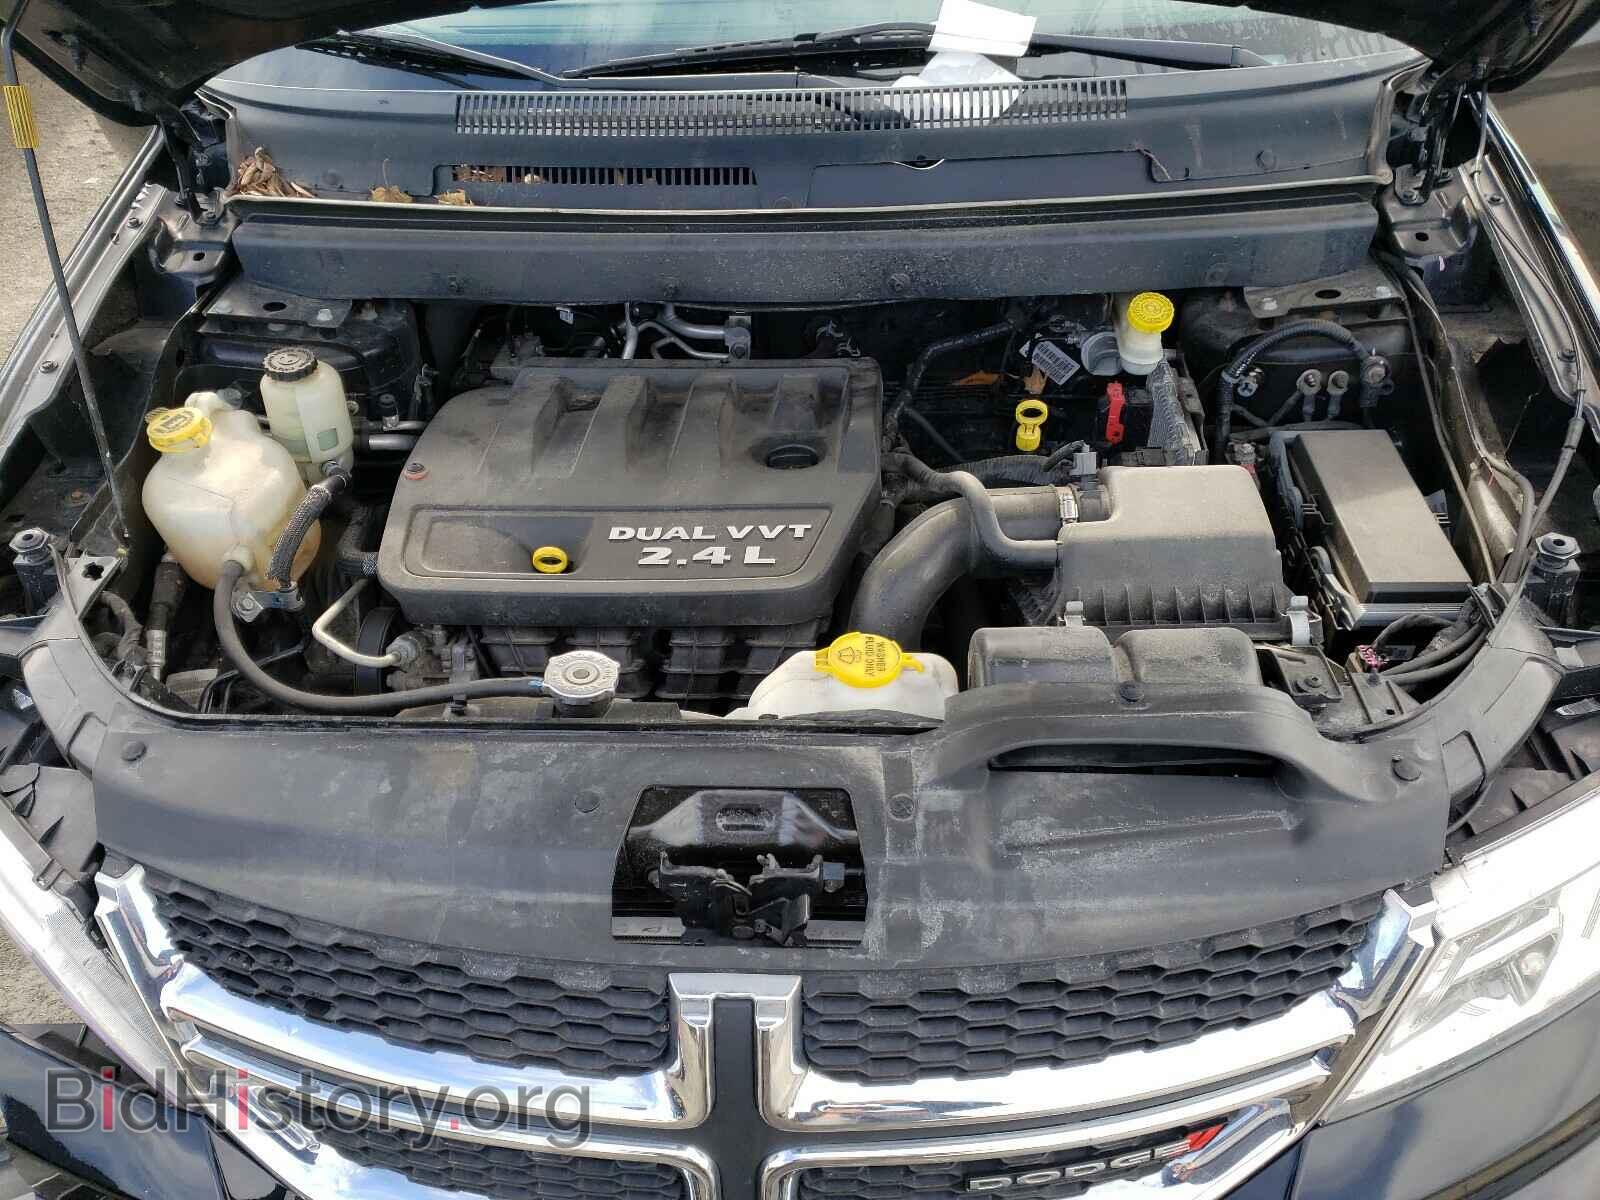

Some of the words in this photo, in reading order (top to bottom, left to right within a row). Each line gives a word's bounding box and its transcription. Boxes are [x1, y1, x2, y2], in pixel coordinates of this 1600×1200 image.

[608, 526, 716, 541] DUAL
[727, 524, 812, 540] VVT
[865, 636, 875, 657] FLUID
[876, 641, 886, 672] WASHER
[865, 658, 875, 677] ONLY
[969, 1138, 1191, 1191] DODGE
